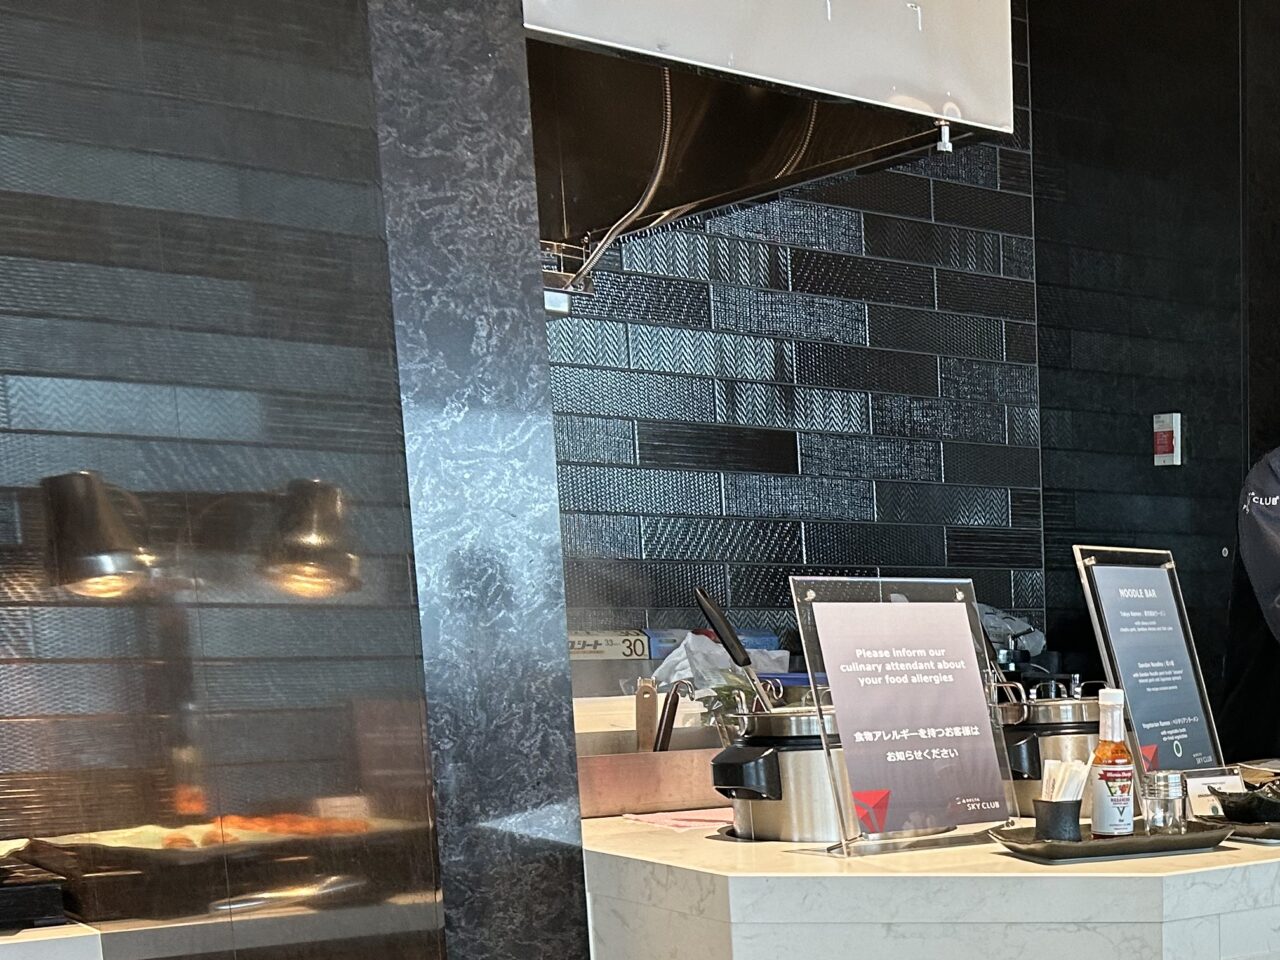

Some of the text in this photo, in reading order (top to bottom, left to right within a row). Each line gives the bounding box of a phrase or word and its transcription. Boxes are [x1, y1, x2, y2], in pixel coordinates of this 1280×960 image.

[1252, 495, 1279, 506] CLUB
[1118, 588, 1158, 599] NOODLE BAR
[621, 638, 645, 657] 30
[855, 647, 946, 659] Please inform our
[839, 659, 967, 673] culinary attendant about
[858, 673, 954, 687] your food allergies
[853, 725, 980, 742] 食物アレルギーを持つお客様は
[886, 748, 959, 762] お知らせください
[966, 801, 1000, 811] SKY CLUB
